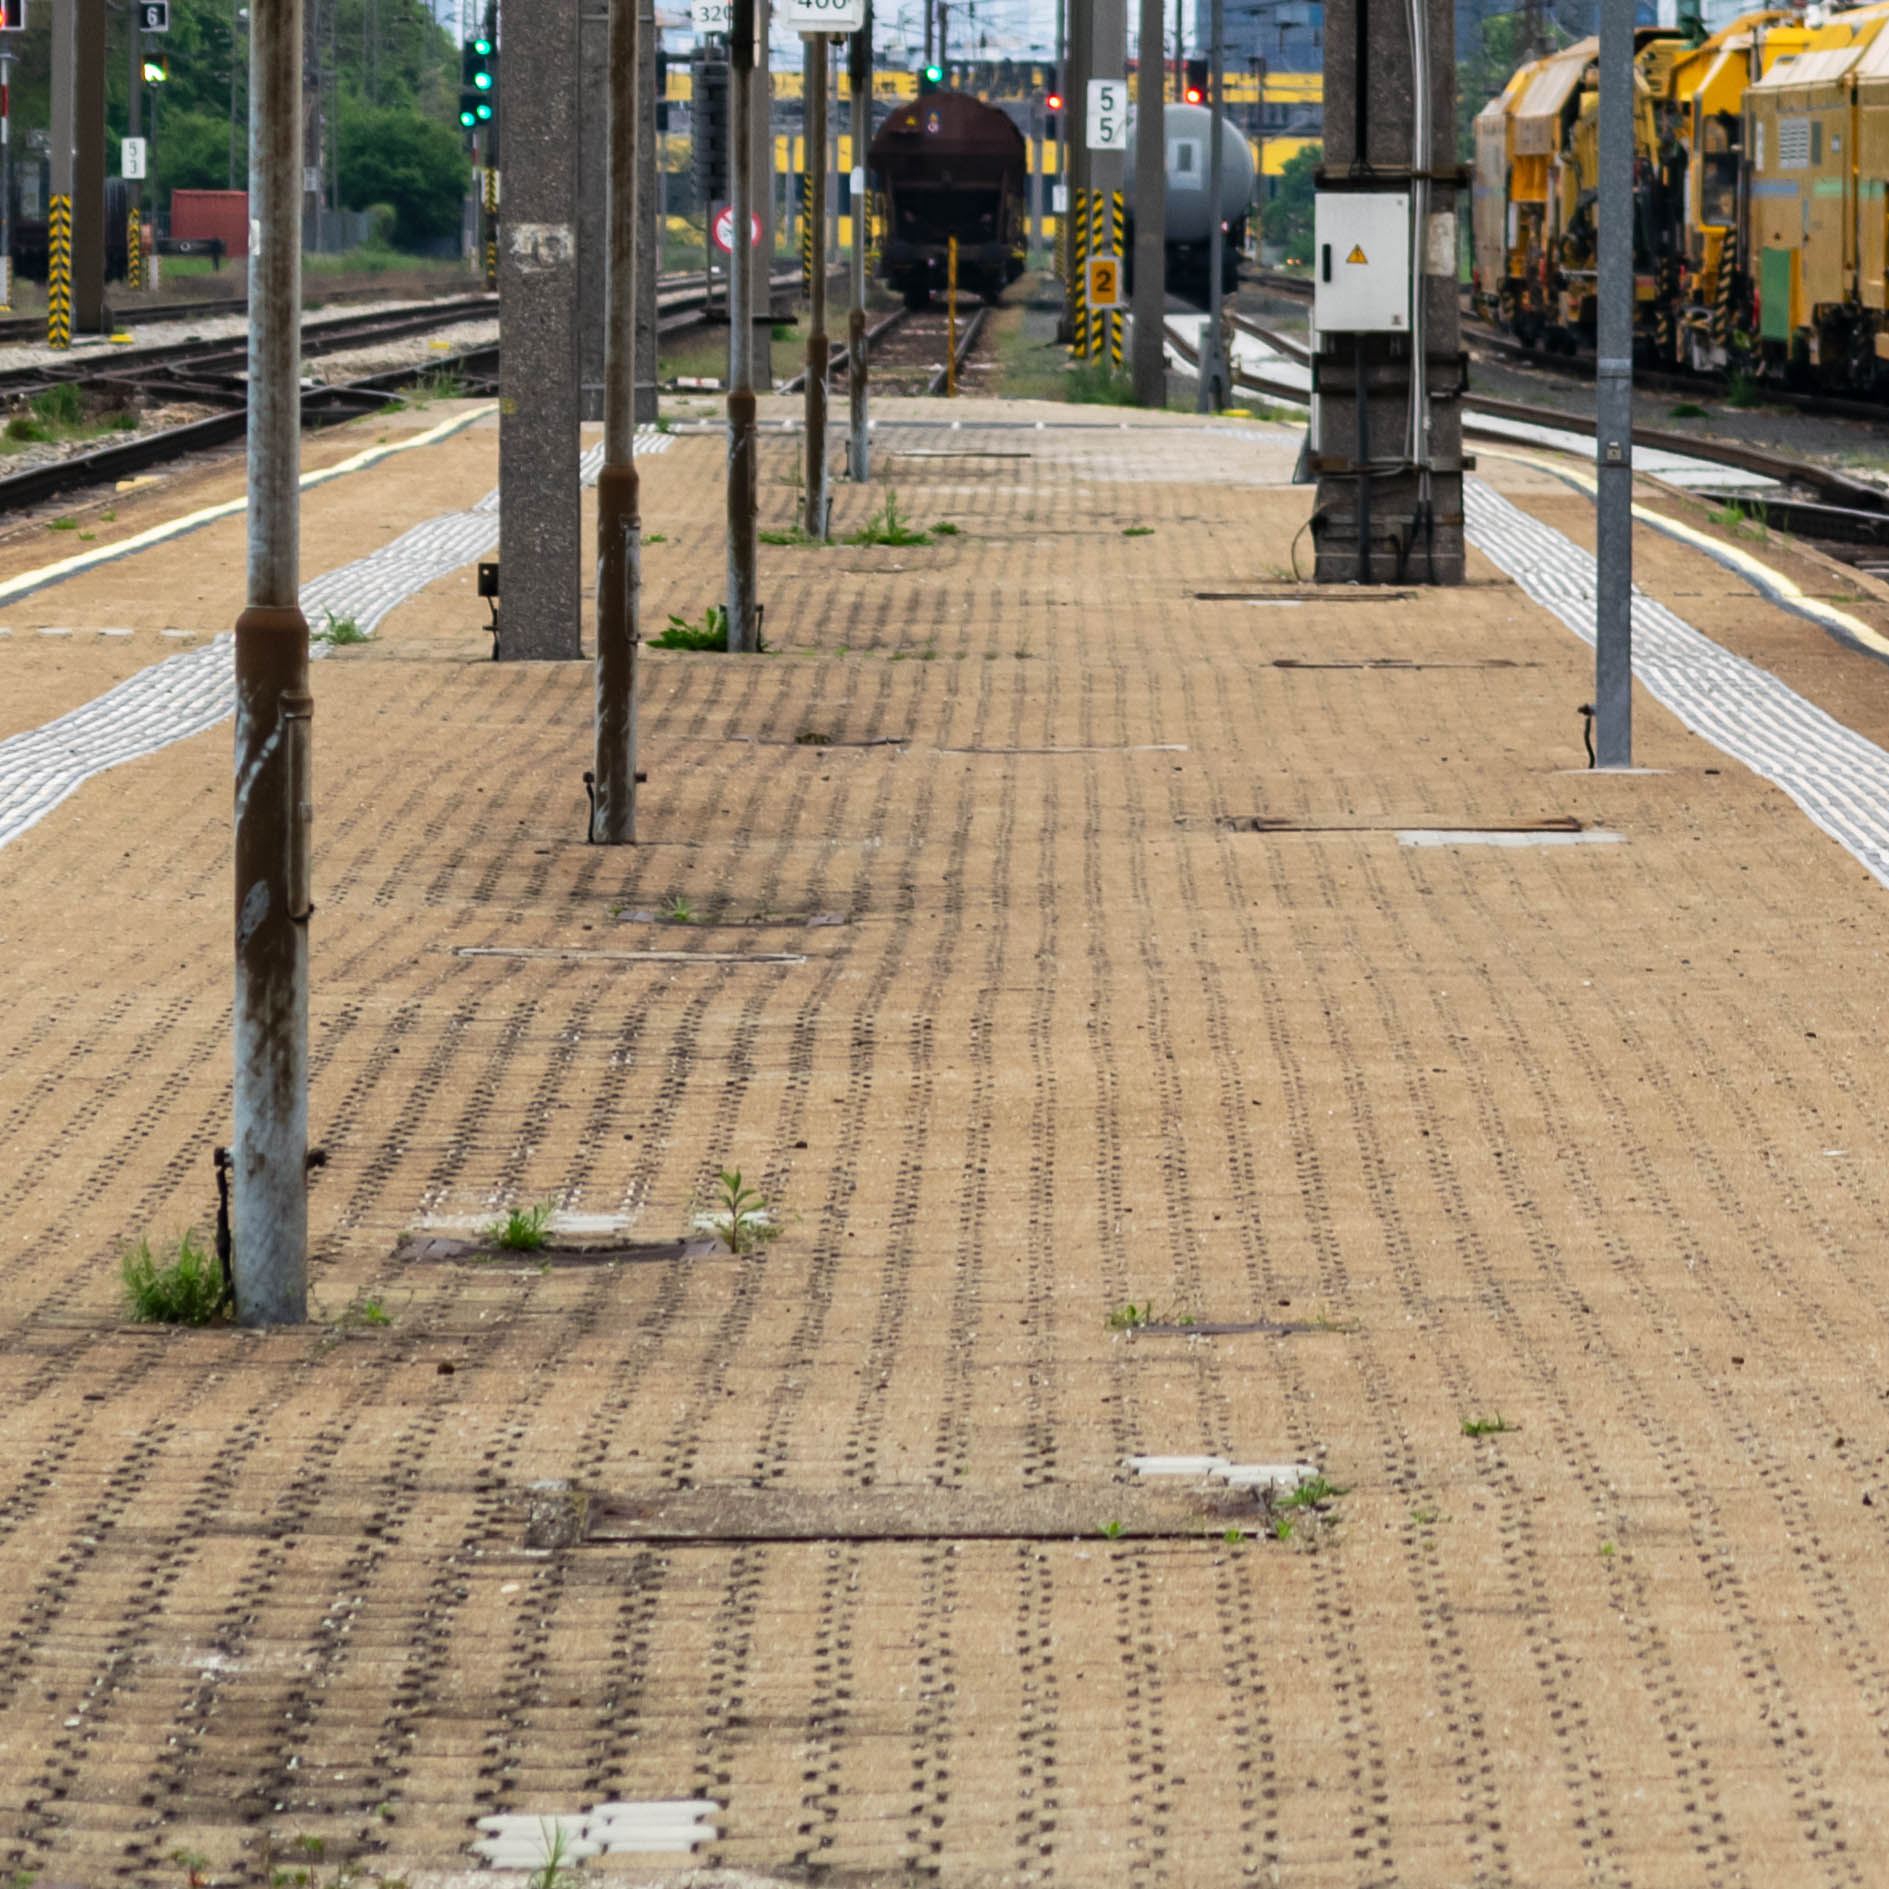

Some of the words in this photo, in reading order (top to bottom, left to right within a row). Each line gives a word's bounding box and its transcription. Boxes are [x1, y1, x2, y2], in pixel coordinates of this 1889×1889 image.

[146, 6, 158, 28] 6
[1099, 86, 1114, 112] 5
[1099, 116, 1114, 143] 5
[1095, 269, 1112, 293] 2
